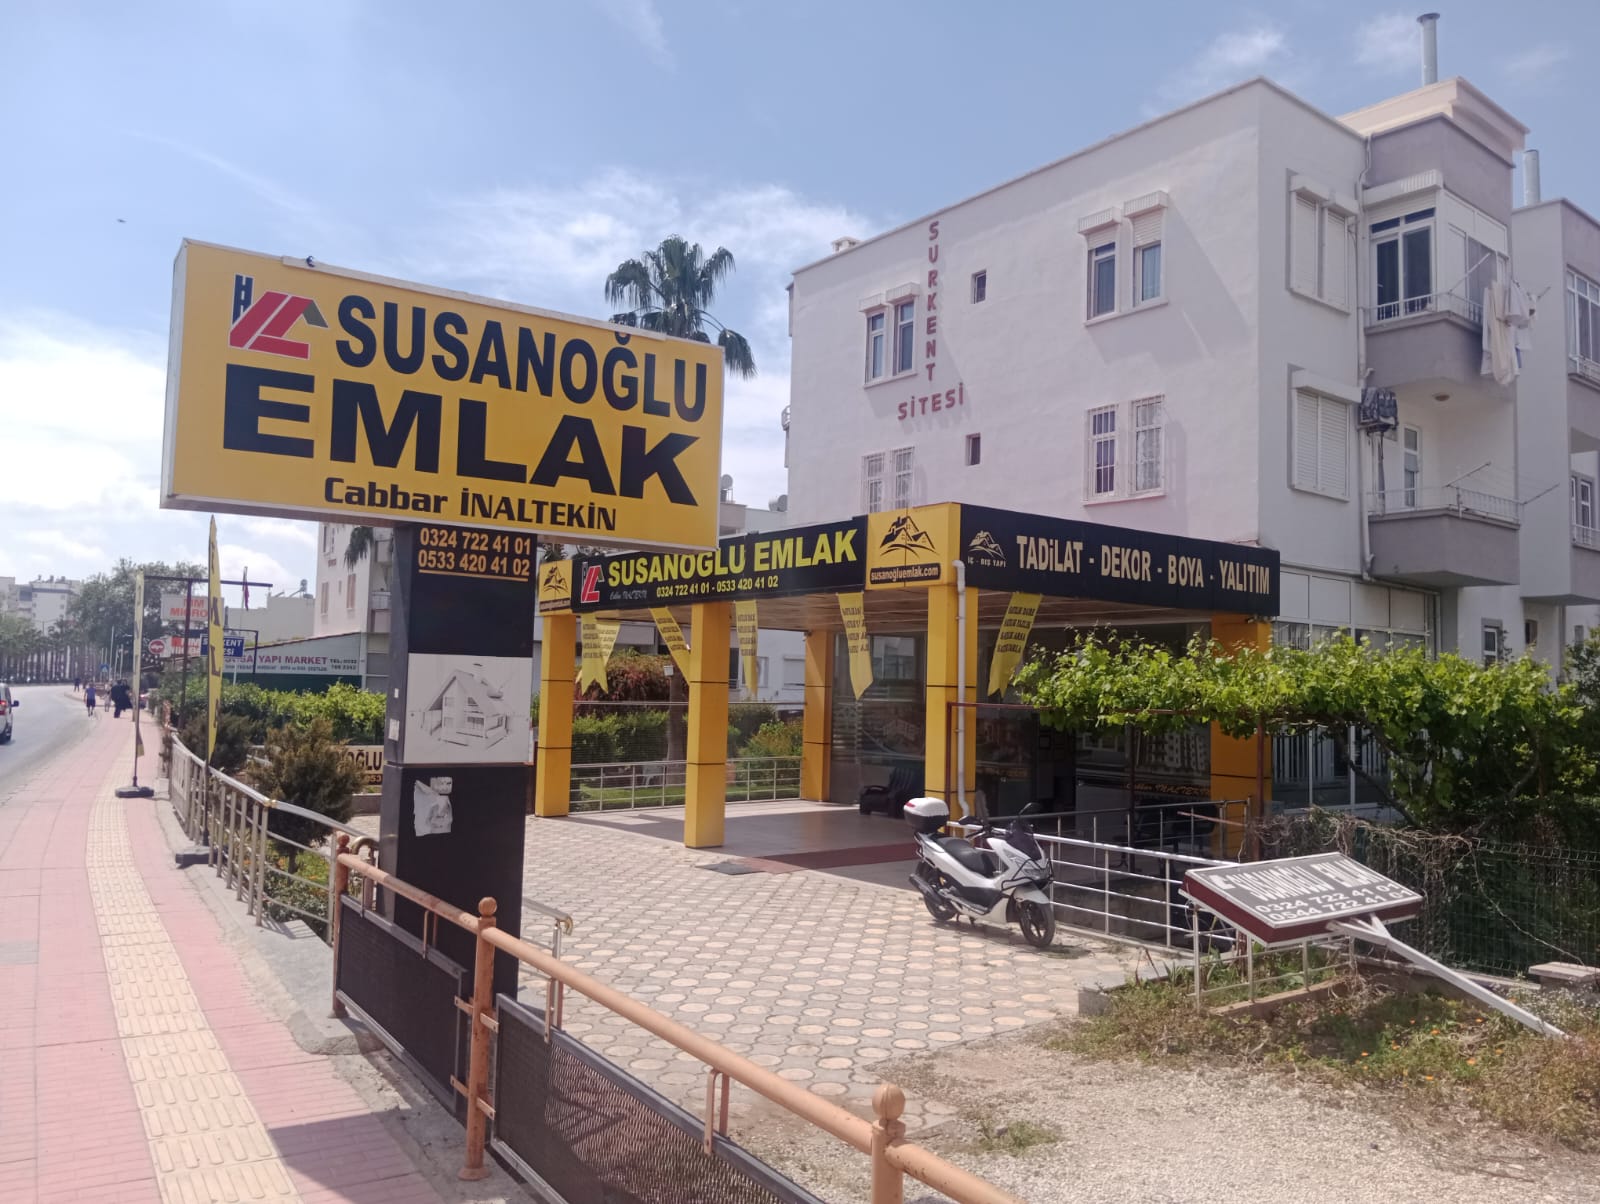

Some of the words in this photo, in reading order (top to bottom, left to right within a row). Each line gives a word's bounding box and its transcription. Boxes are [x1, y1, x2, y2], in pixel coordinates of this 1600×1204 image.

[925, 221, 939, 381] SURKENT
[336, 295, 707, 422] SUSANOĞLU
[223, 363, 700, 506] EMLAK
[324, 477, 449, 515] Cabbar
[460, 487, 617, 531] İNALTEKİN
[420, 527, 457, 548] 0324
[462, 531, 489, 551] 722
[492, 535, 509, 553] 41
[514, 537, 531, 555] 01
[753, 529, 859, 572] EMLAK
[418, 549, 455, 569] 0533
[459, 553, 487, 573] 420
[490, 556, 507, 574] 41
[512, 558, 530, 576] 02
[1101, 544, 1151, 582] DEKOR
[1168, 554, 1204, 588] BOYA
[1219, 559, 1270, 594] YALITIM
[656, 586, 674, 598] 0324
[675, 584, 689, 596] 722
[689, 583, 699, 595] 41
[701, 582, 710, 593] 01
[716, 579, 736, 592] 0533
[737, 577, 753, 590] 420
[754, 576, 765, 589] 41
[767, 575, 779, 588] 02
[259, 655, 282, 664] YAPI
[285, 655, 328, 665] MARKET
[1255, 900, 1308, 912] 0324
[1308, 893, 1350, 903] 722
[1352, 888, 1374, 896] 41
[1375, 883, 1399, 892] 01
[1268, 907, 1323, 920] 0544
[1322, 900, 1363, 911] 722
[1365, 895, 1387, 903] 41
[1388, 890, 1412, 898] 01
